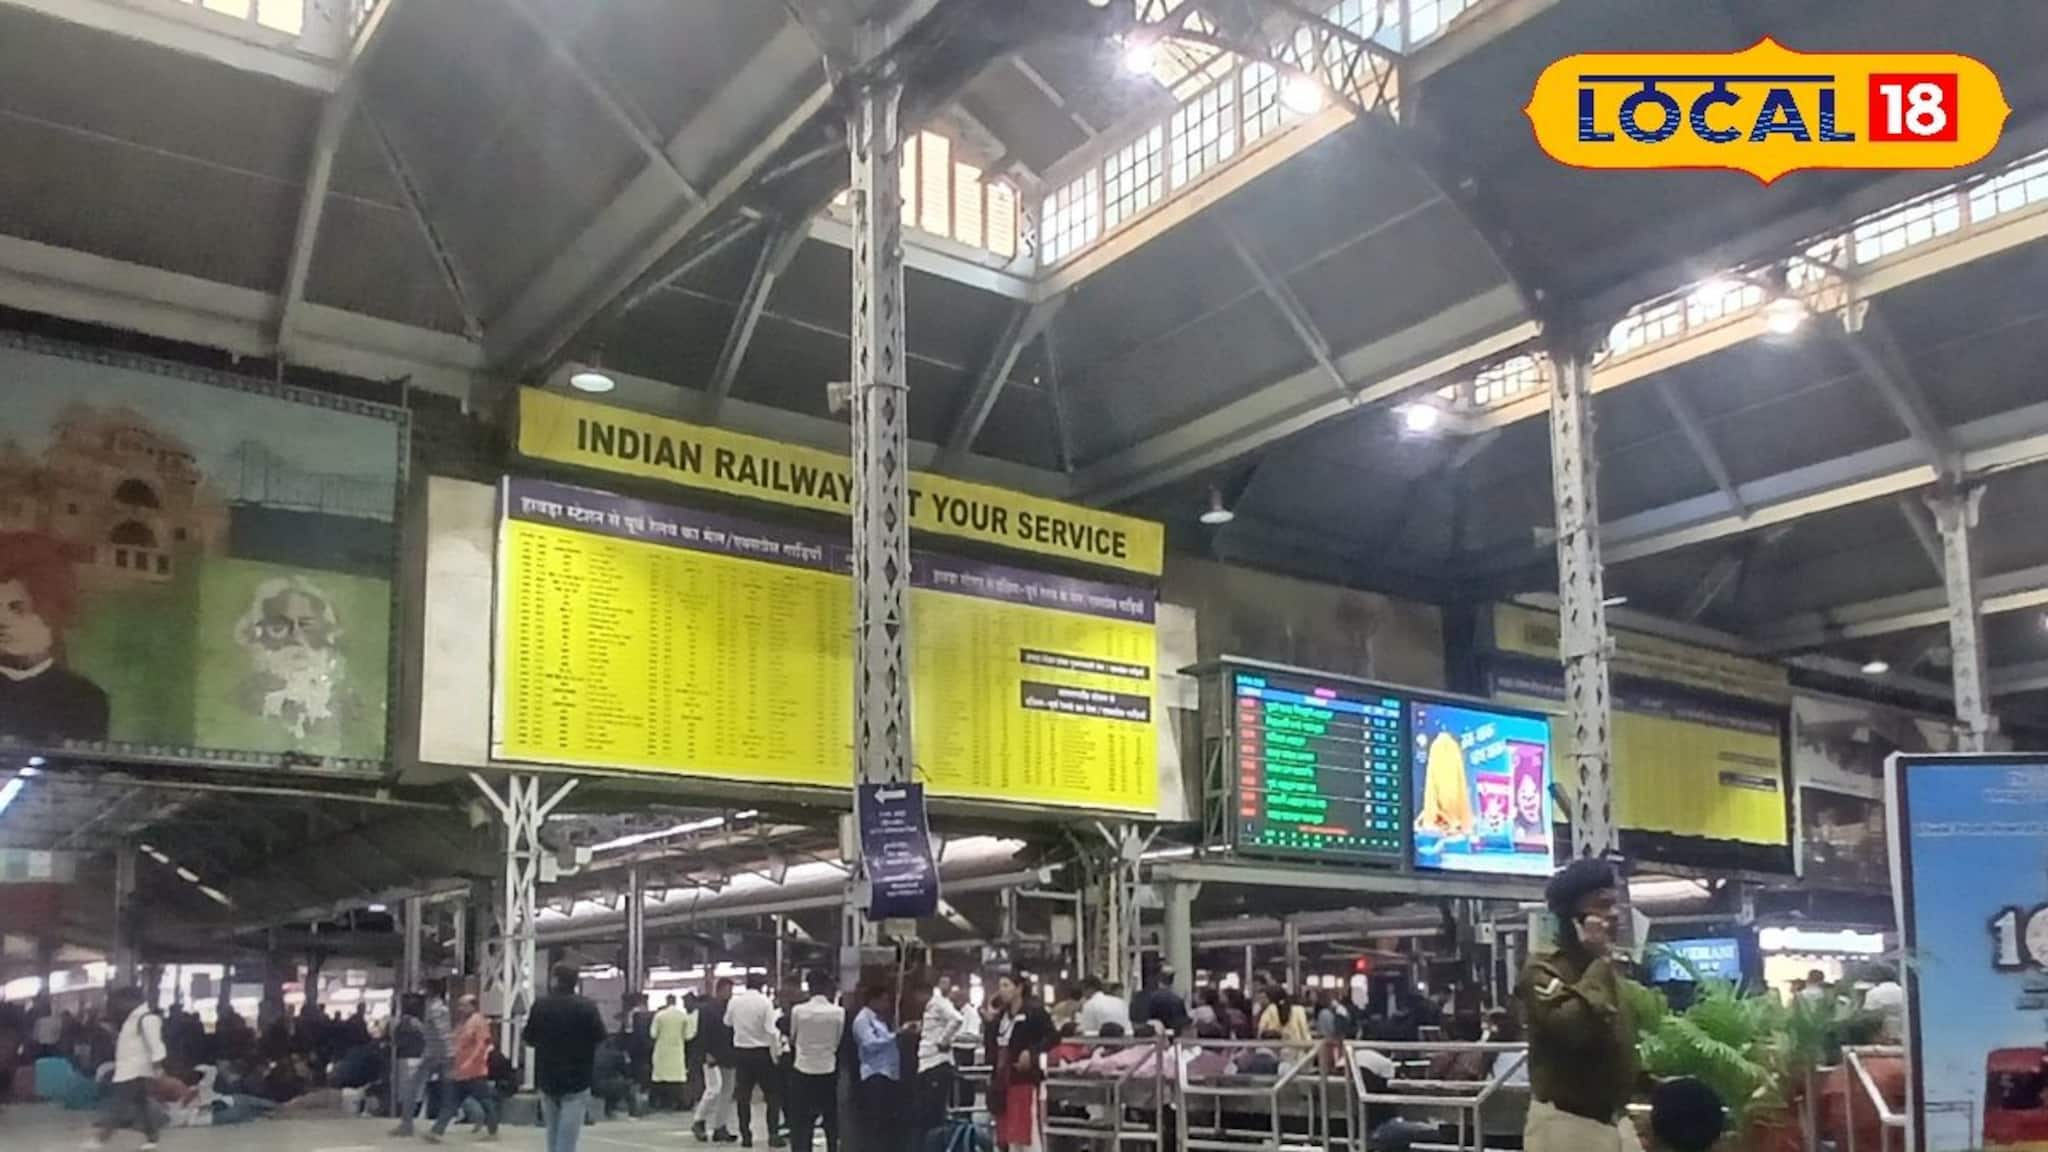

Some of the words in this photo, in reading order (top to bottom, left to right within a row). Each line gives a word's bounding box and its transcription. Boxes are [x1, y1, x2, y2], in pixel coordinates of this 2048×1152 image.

[577, 418, 702, 474] INDIAN
[714, 447, 853, 505] RAILWAY
[907, 488, 922, 517] T
[931, 493, 1008, 535] YOUR
[1017, 512, 1127, 559] SERVICE
